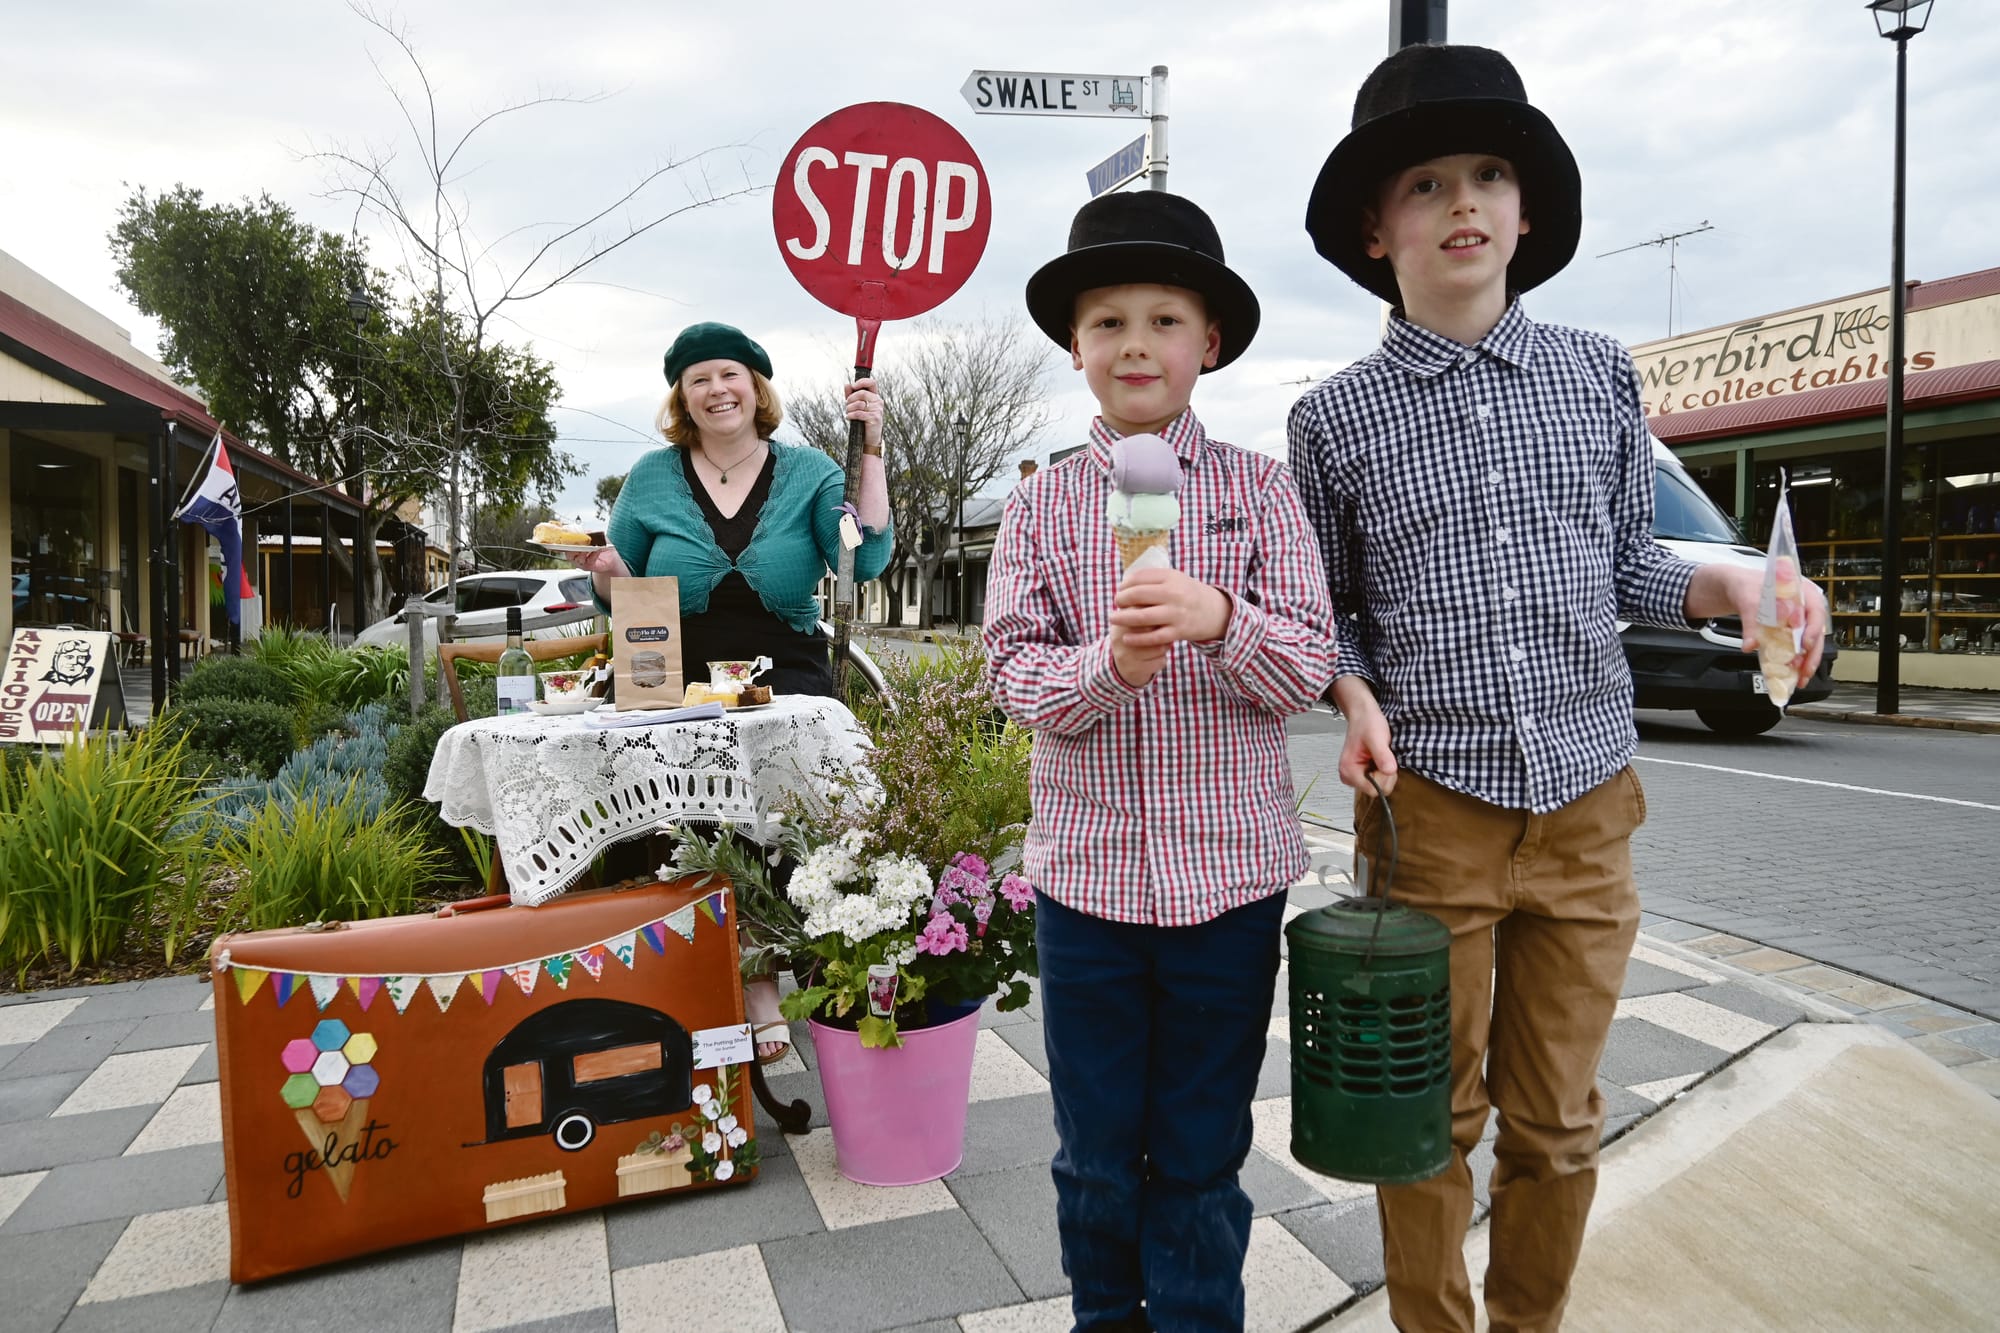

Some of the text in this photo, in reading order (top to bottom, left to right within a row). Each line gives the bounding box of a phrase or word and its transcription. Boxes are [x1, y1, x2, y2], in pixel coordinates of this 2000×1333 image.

[976, 76, 1100, 109] SWALE ST
[1093, 140, 1141, 194] TOILETS
[785, 146, 979, 274] STOP
[1659, 392, 1674, 416] &
[0, 630, 42, 738] ANTIQUES
[35, 702, 89, 722] OPEN
[284, 1119, 400, 1199] gelato
